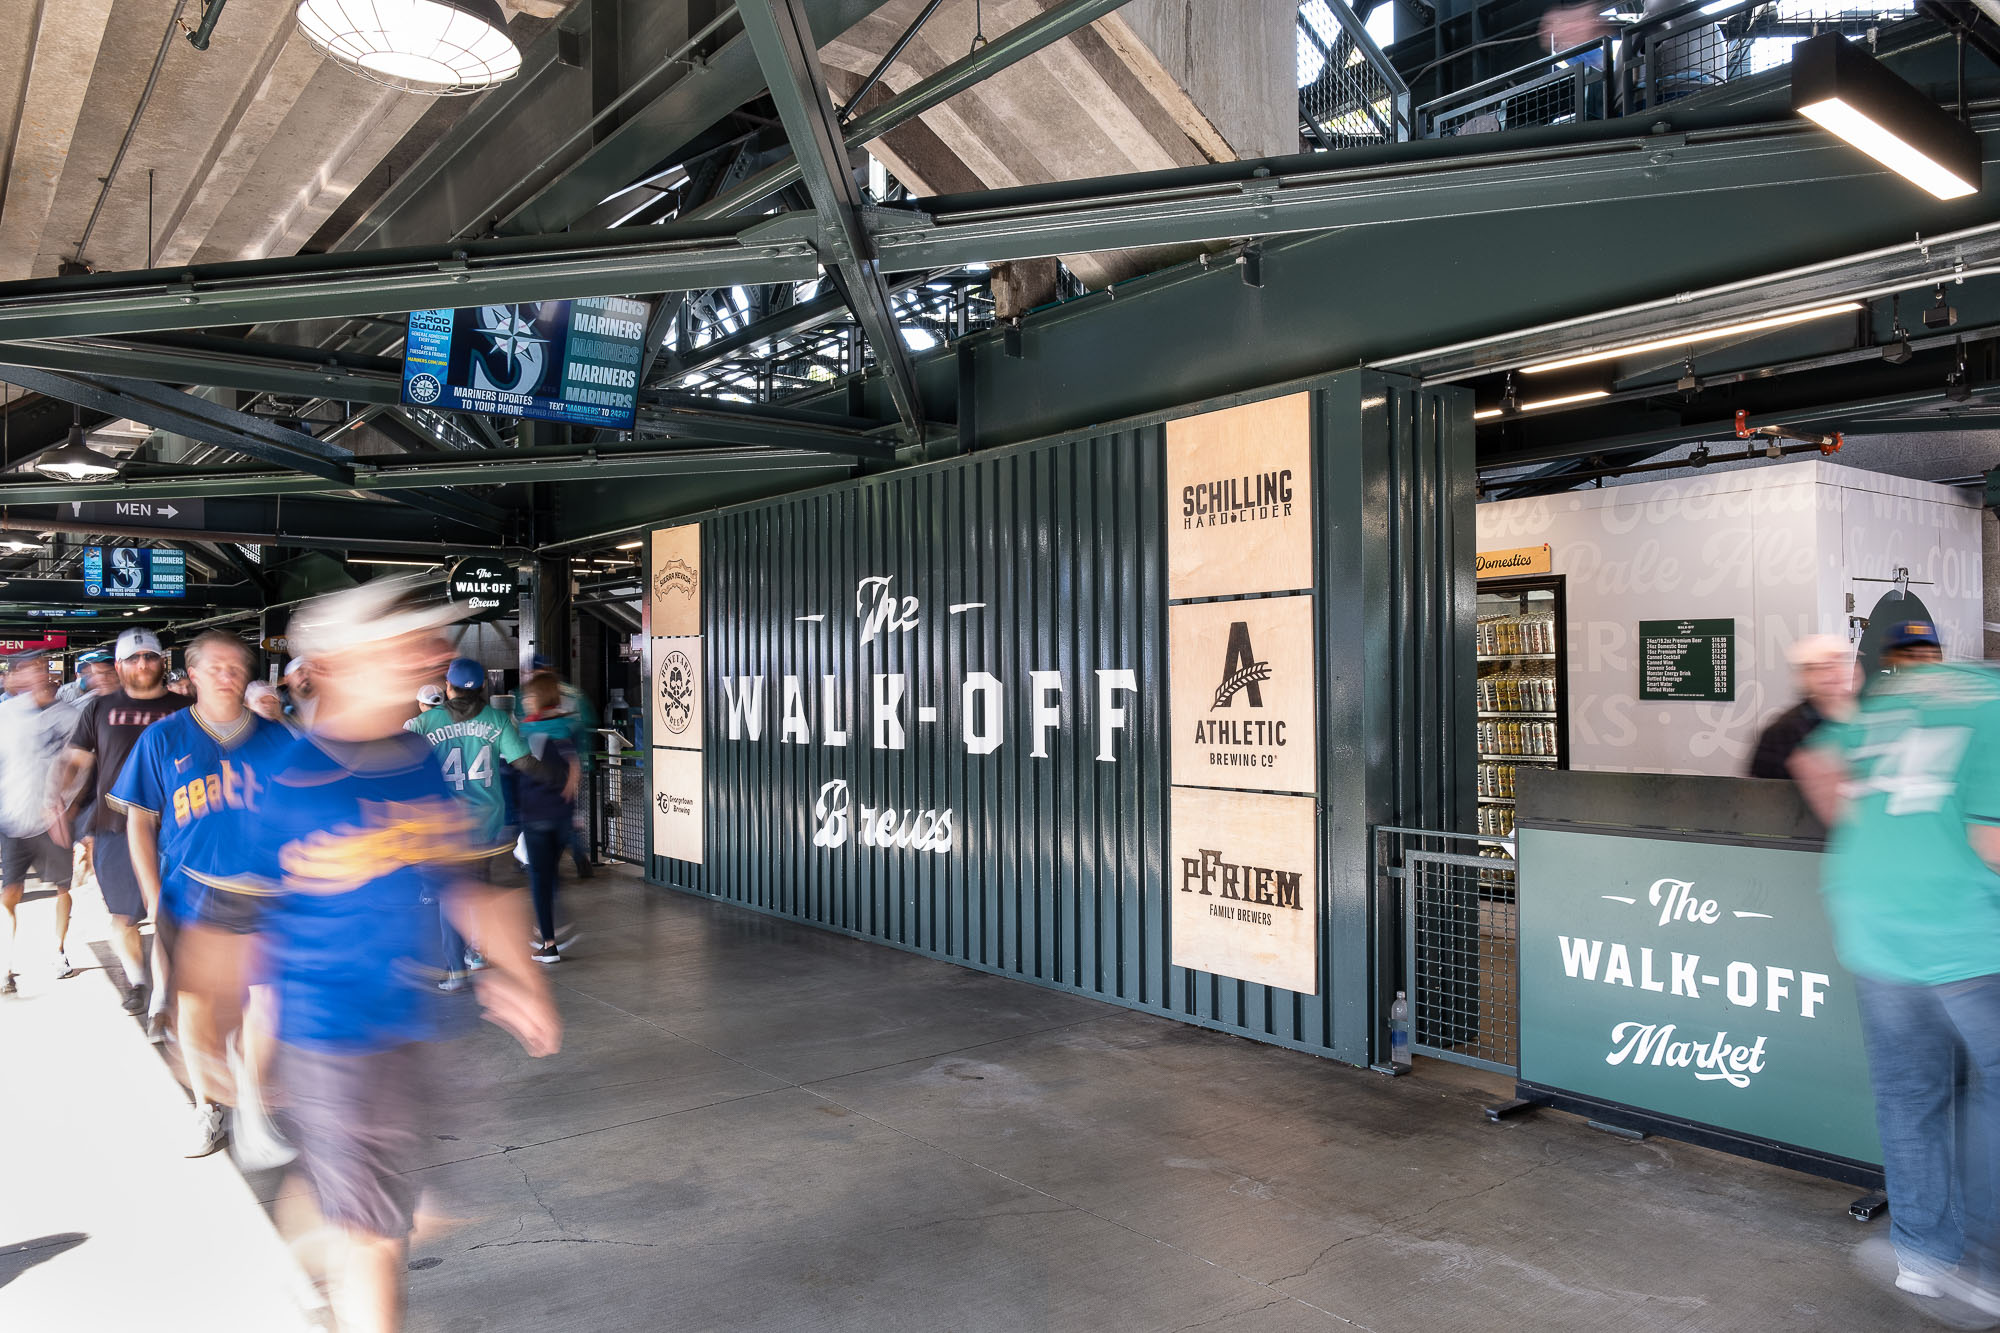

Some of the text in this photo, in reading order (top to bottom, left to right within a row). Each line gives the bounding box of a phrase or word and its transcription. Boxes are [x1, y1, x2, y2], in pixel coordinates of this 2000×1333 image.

[577, 297, 645, 316] MARINERS
[411, 321, 452, 333] SQUAD
[413, 315, 450, 325] J-ROD
[574, 313, 642, 340] MARINERS
[570, 338, 639, 364] MARINERS
[568, 362, 636, 388] MARINERS
[454, 387, 533, 406] MARINERS UPDATES
[462, 399, 472, 410] TO
[474, 401, 495, 413] YOUR
[497, 404, 524, 415] PHONE
[566, 386, 633, 408] MARINERS
[549, 402, 564, 411] TEXT
[602, 408, 609, 417] TO
[1183, 469, 1292, 517] SCHILLING
[116, 502, 151, 516] MEN
[1184, 503, 1292, 530] HARD CIDER
[476, 568, 492, 579] The
[1476, 554, 1531, 571] Domestics
[1554, 527, 1819, 601] Pale Ale
[456, 582, 512, 593] WALK-OFF
[660, 572, 691, 587] SIERRA NEVADA
[468, 597, 499, 608] Brews
[856, 574, 920, 647] The
[670, 716, 684, 727] BEER
[722, 668, 1138, 762] WALK-OFF
[1194, 720, 1287, 746] ATHLETIC
[441, 745, 493, 791] 44
[1210, 753, 1257, 767] BREWING
[669, 795, 694, 806] Georgetown
[673, 805, 691, 816] Brewing
[812, 778, 952, 854] Brews
[1181, 848, 1304, 910] PFRIEM
[1648, 878, 1722, 926] The
[1209, 903, 1272, 926] FAMILY BREWERS
[1557, 935, 1830, 1018] WALK-OFF
[1605, 1021, 1768, 1088] Market
